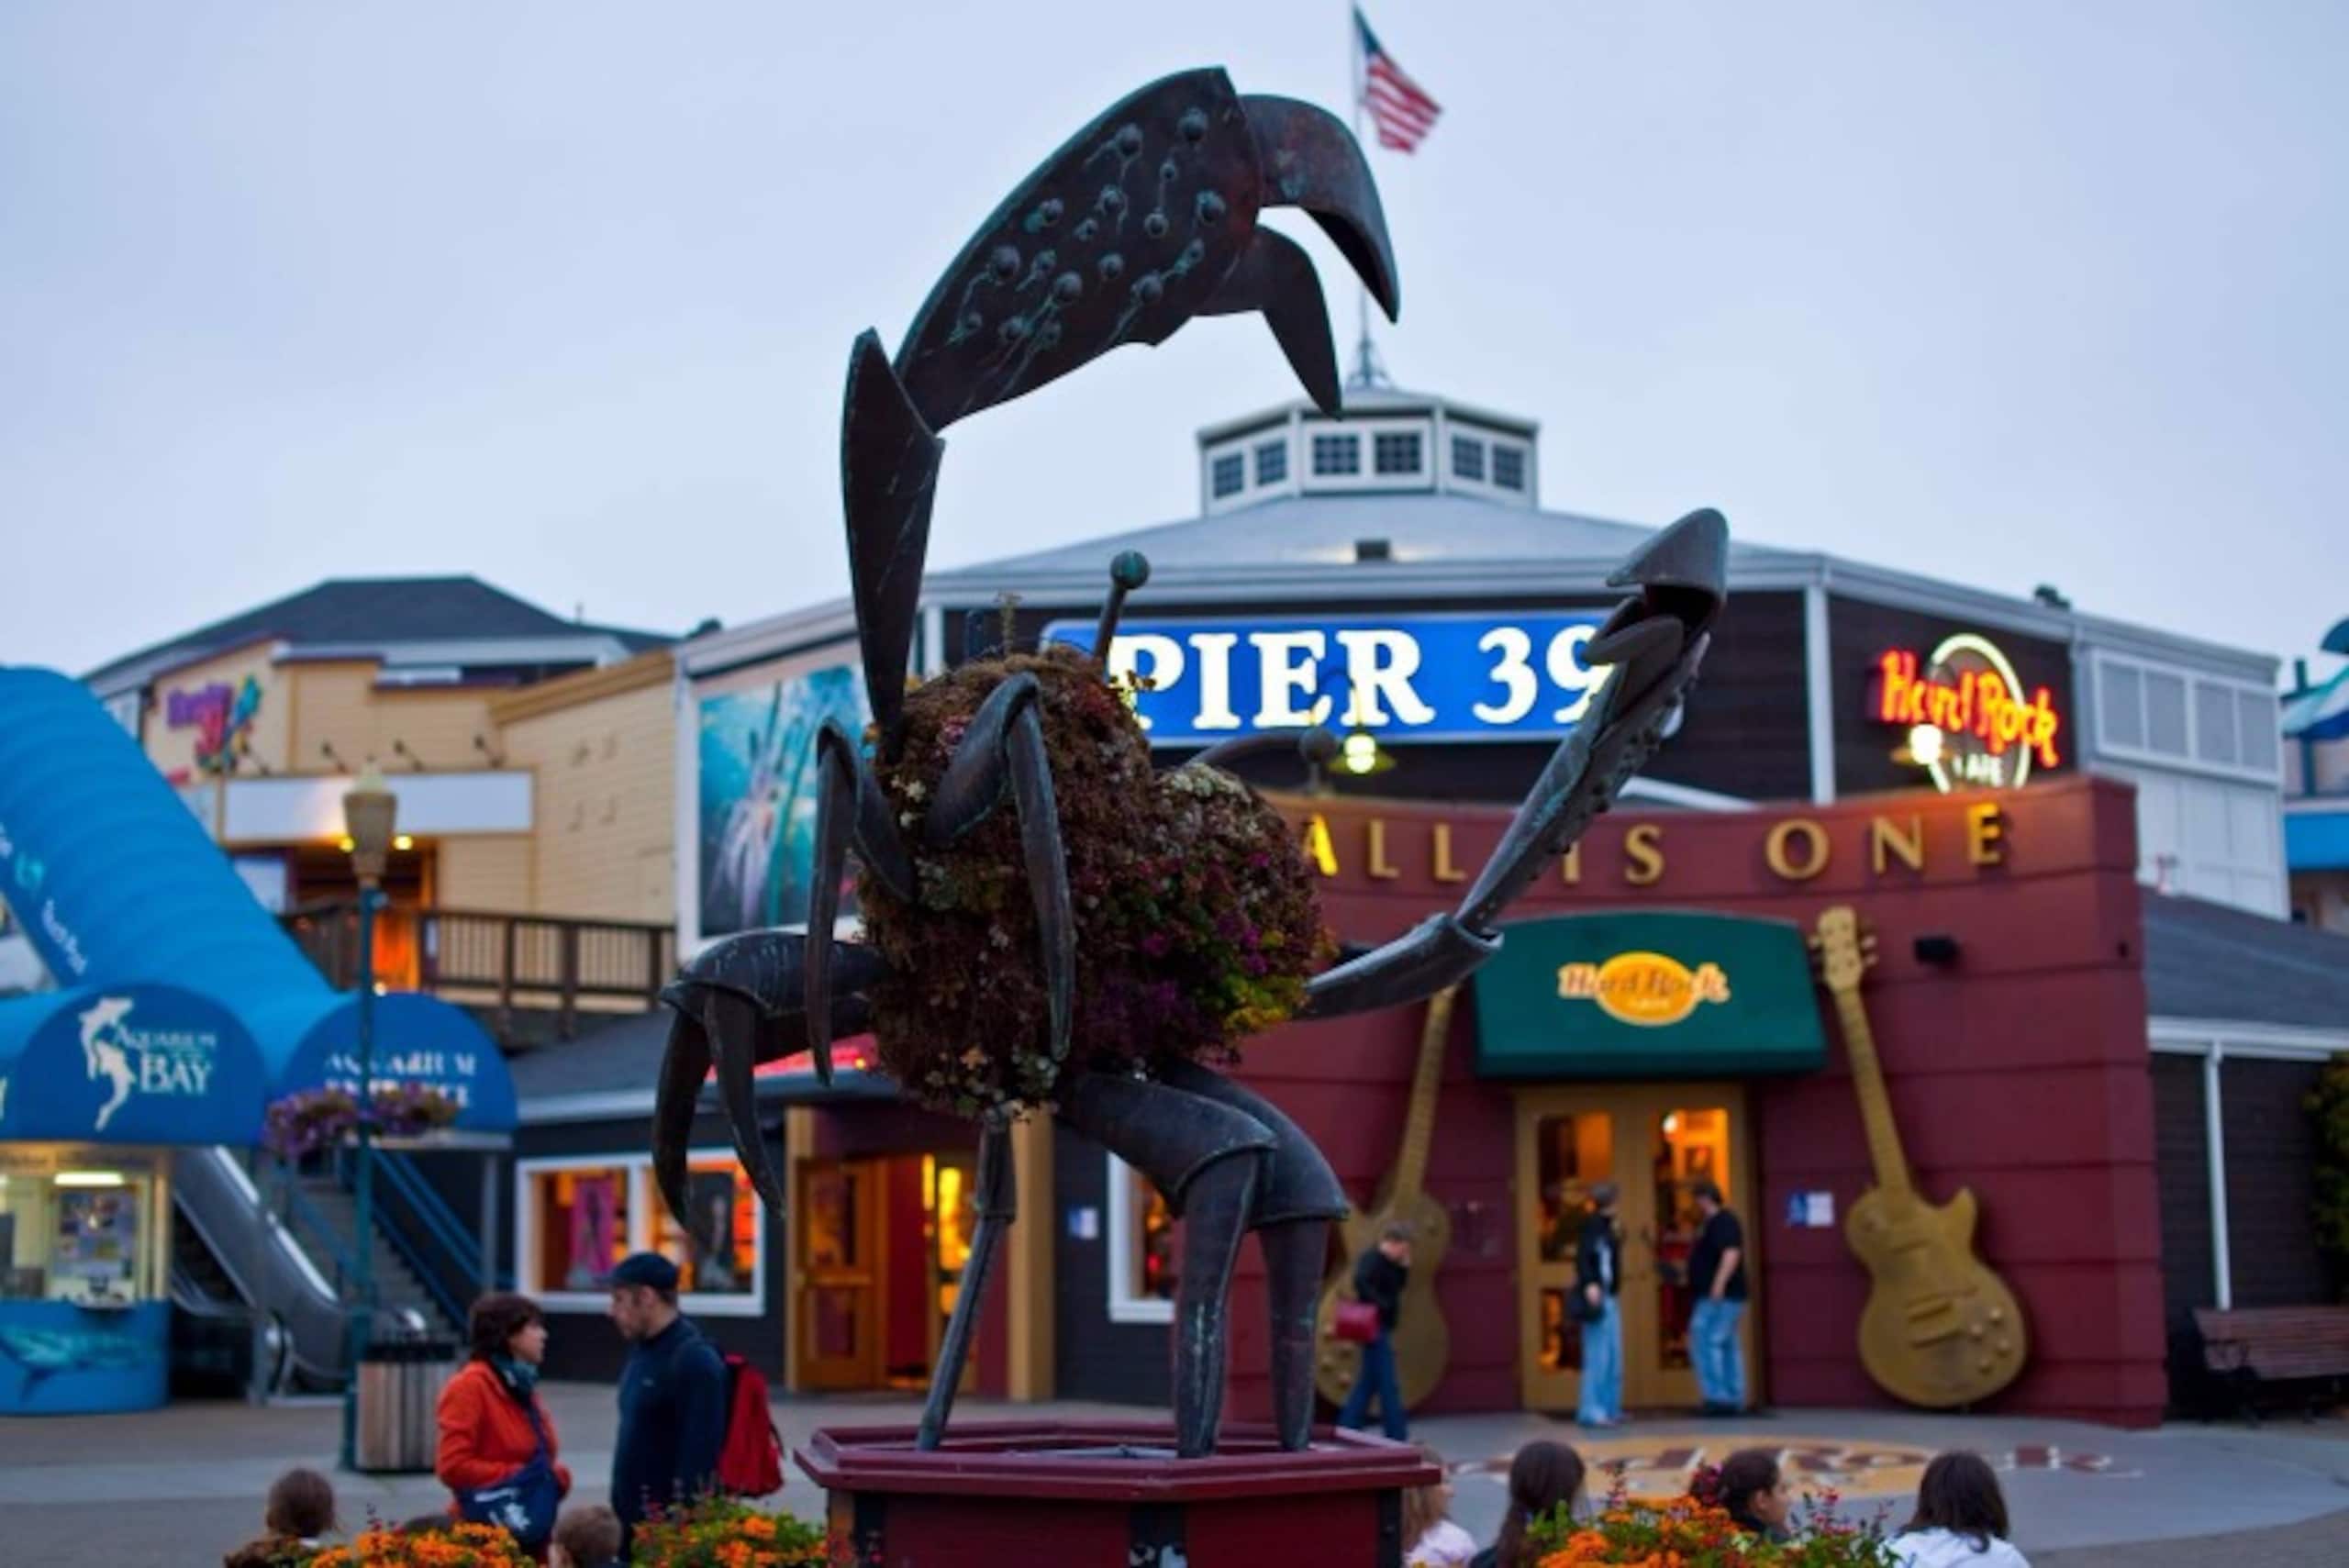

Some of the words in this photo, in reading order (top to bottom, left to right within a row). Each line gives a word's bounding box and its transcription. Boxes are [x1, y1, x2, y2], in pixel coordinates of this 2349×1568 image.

[1108, 629, 1436, 729] PIER
[1472, 624, 1615, 724] 39
[1880, 648, 1974, 733] Hard
[1976, 670, 2060, 769] Rock
[1302, 813, 1466, 882] ALL
[1563, 824, 1664, 884] IS
[1765, 801, 2002, 880] ONE
[140, 1052, 213, 1093] BAY
